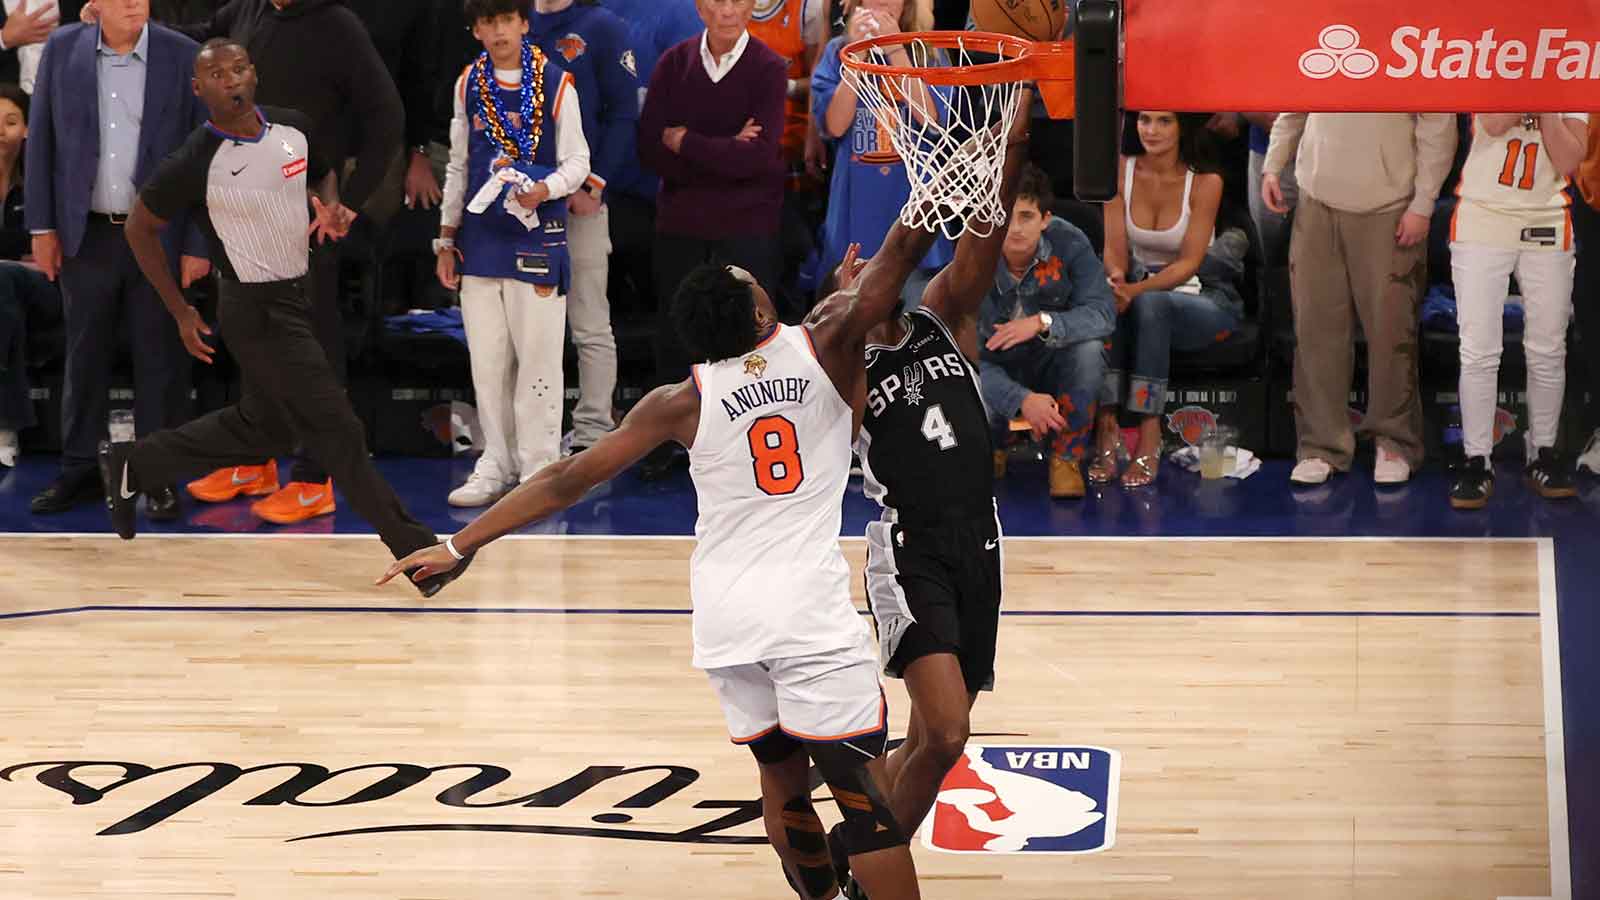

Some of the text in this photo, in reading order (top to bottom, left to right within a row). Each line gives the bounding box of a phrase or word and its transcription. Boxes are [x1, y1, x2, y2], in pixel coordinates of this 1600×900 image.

[1385, 25, 1527, 80] State
[1498, 138, 1540, 191] 11
[721, 377, 811, 421] ANUNOBY
[867, 353, 965, 418] SPURS
[920, 404, 959, 451] 4
[747, 414, 804, 495] 8
[1005, 751, 1091, 770] NBA
